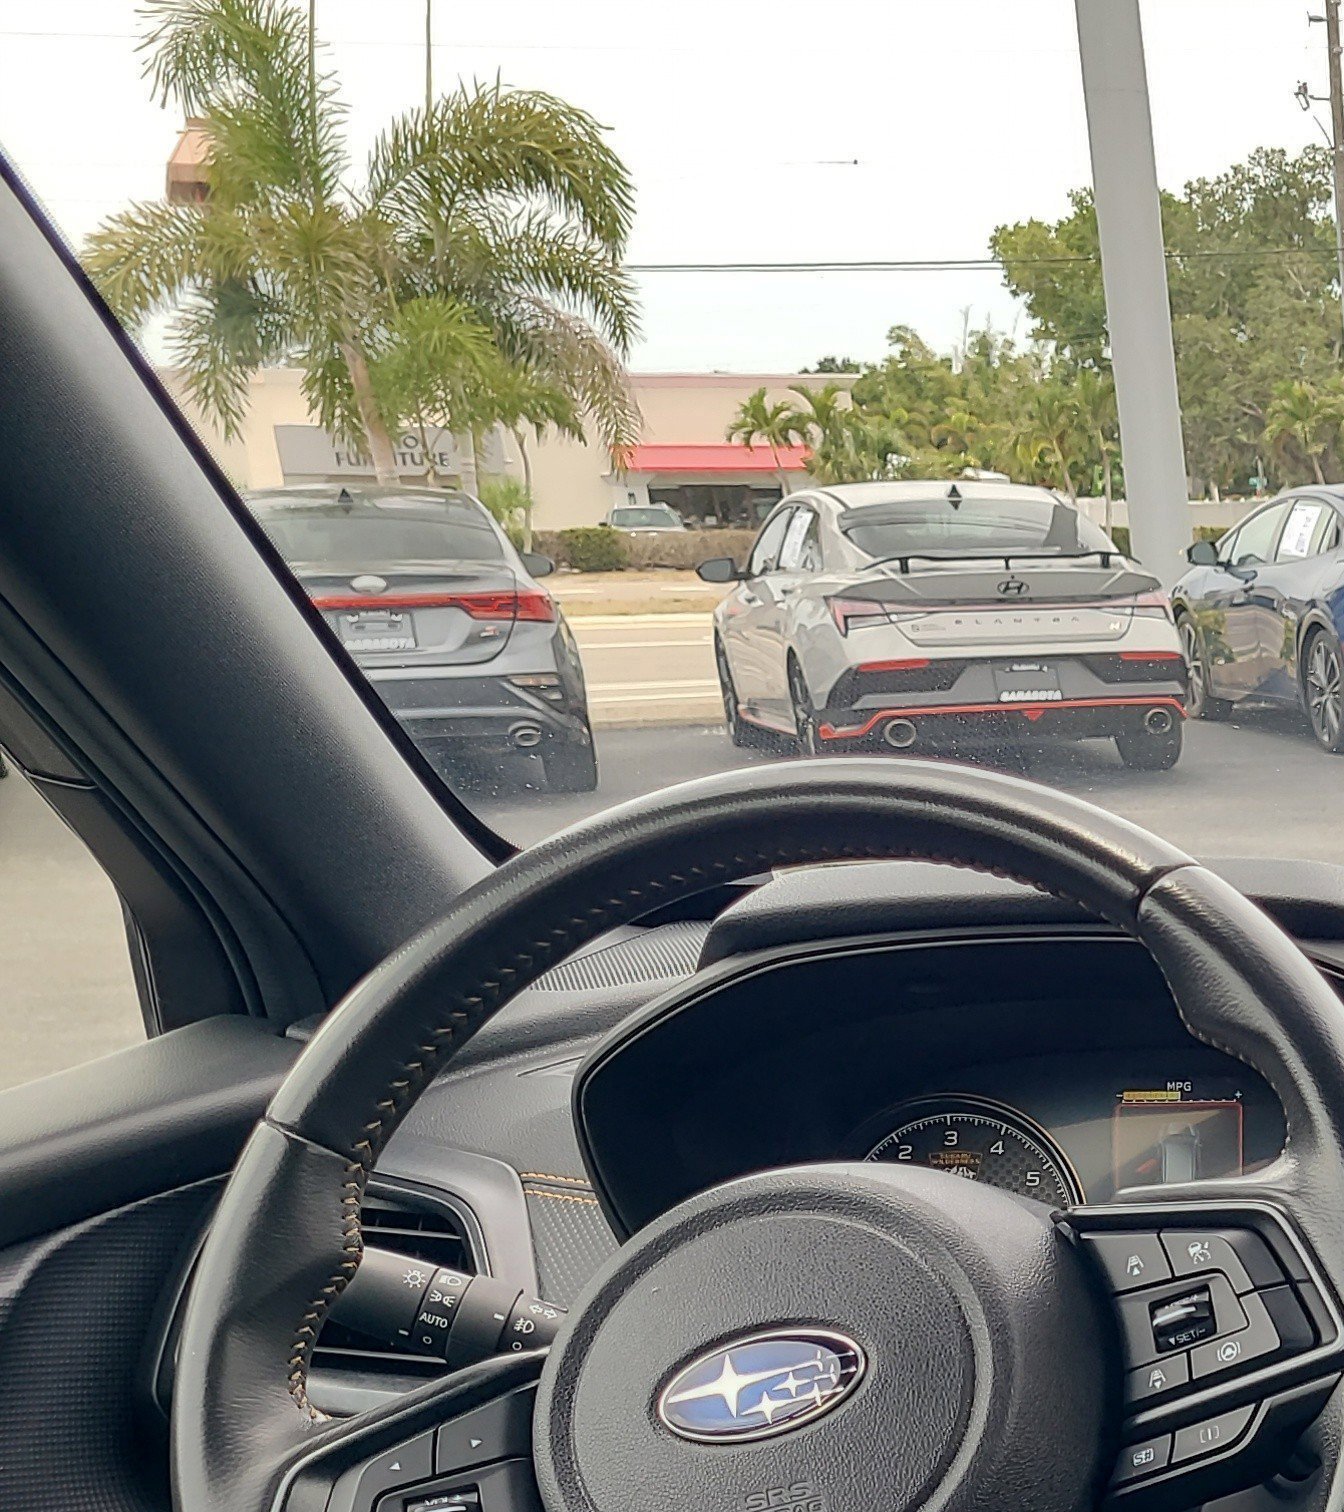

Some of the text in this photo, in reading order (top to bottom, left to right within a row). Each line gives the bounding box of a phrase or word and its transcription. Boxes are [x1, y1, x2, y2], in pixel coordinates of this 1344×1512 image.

[1166, 1081, 1192, 1092] MPG
[943, 1130, 958, 1146] 3
[898, 1145, 913, 1160] 2
[989, 1140, 1005, 1155] 4
[1025, 1171, 1041, 1187] 5
[419, 1312, 448, 1329] AUTO
[744, 1481, 814, 1510] SRS
